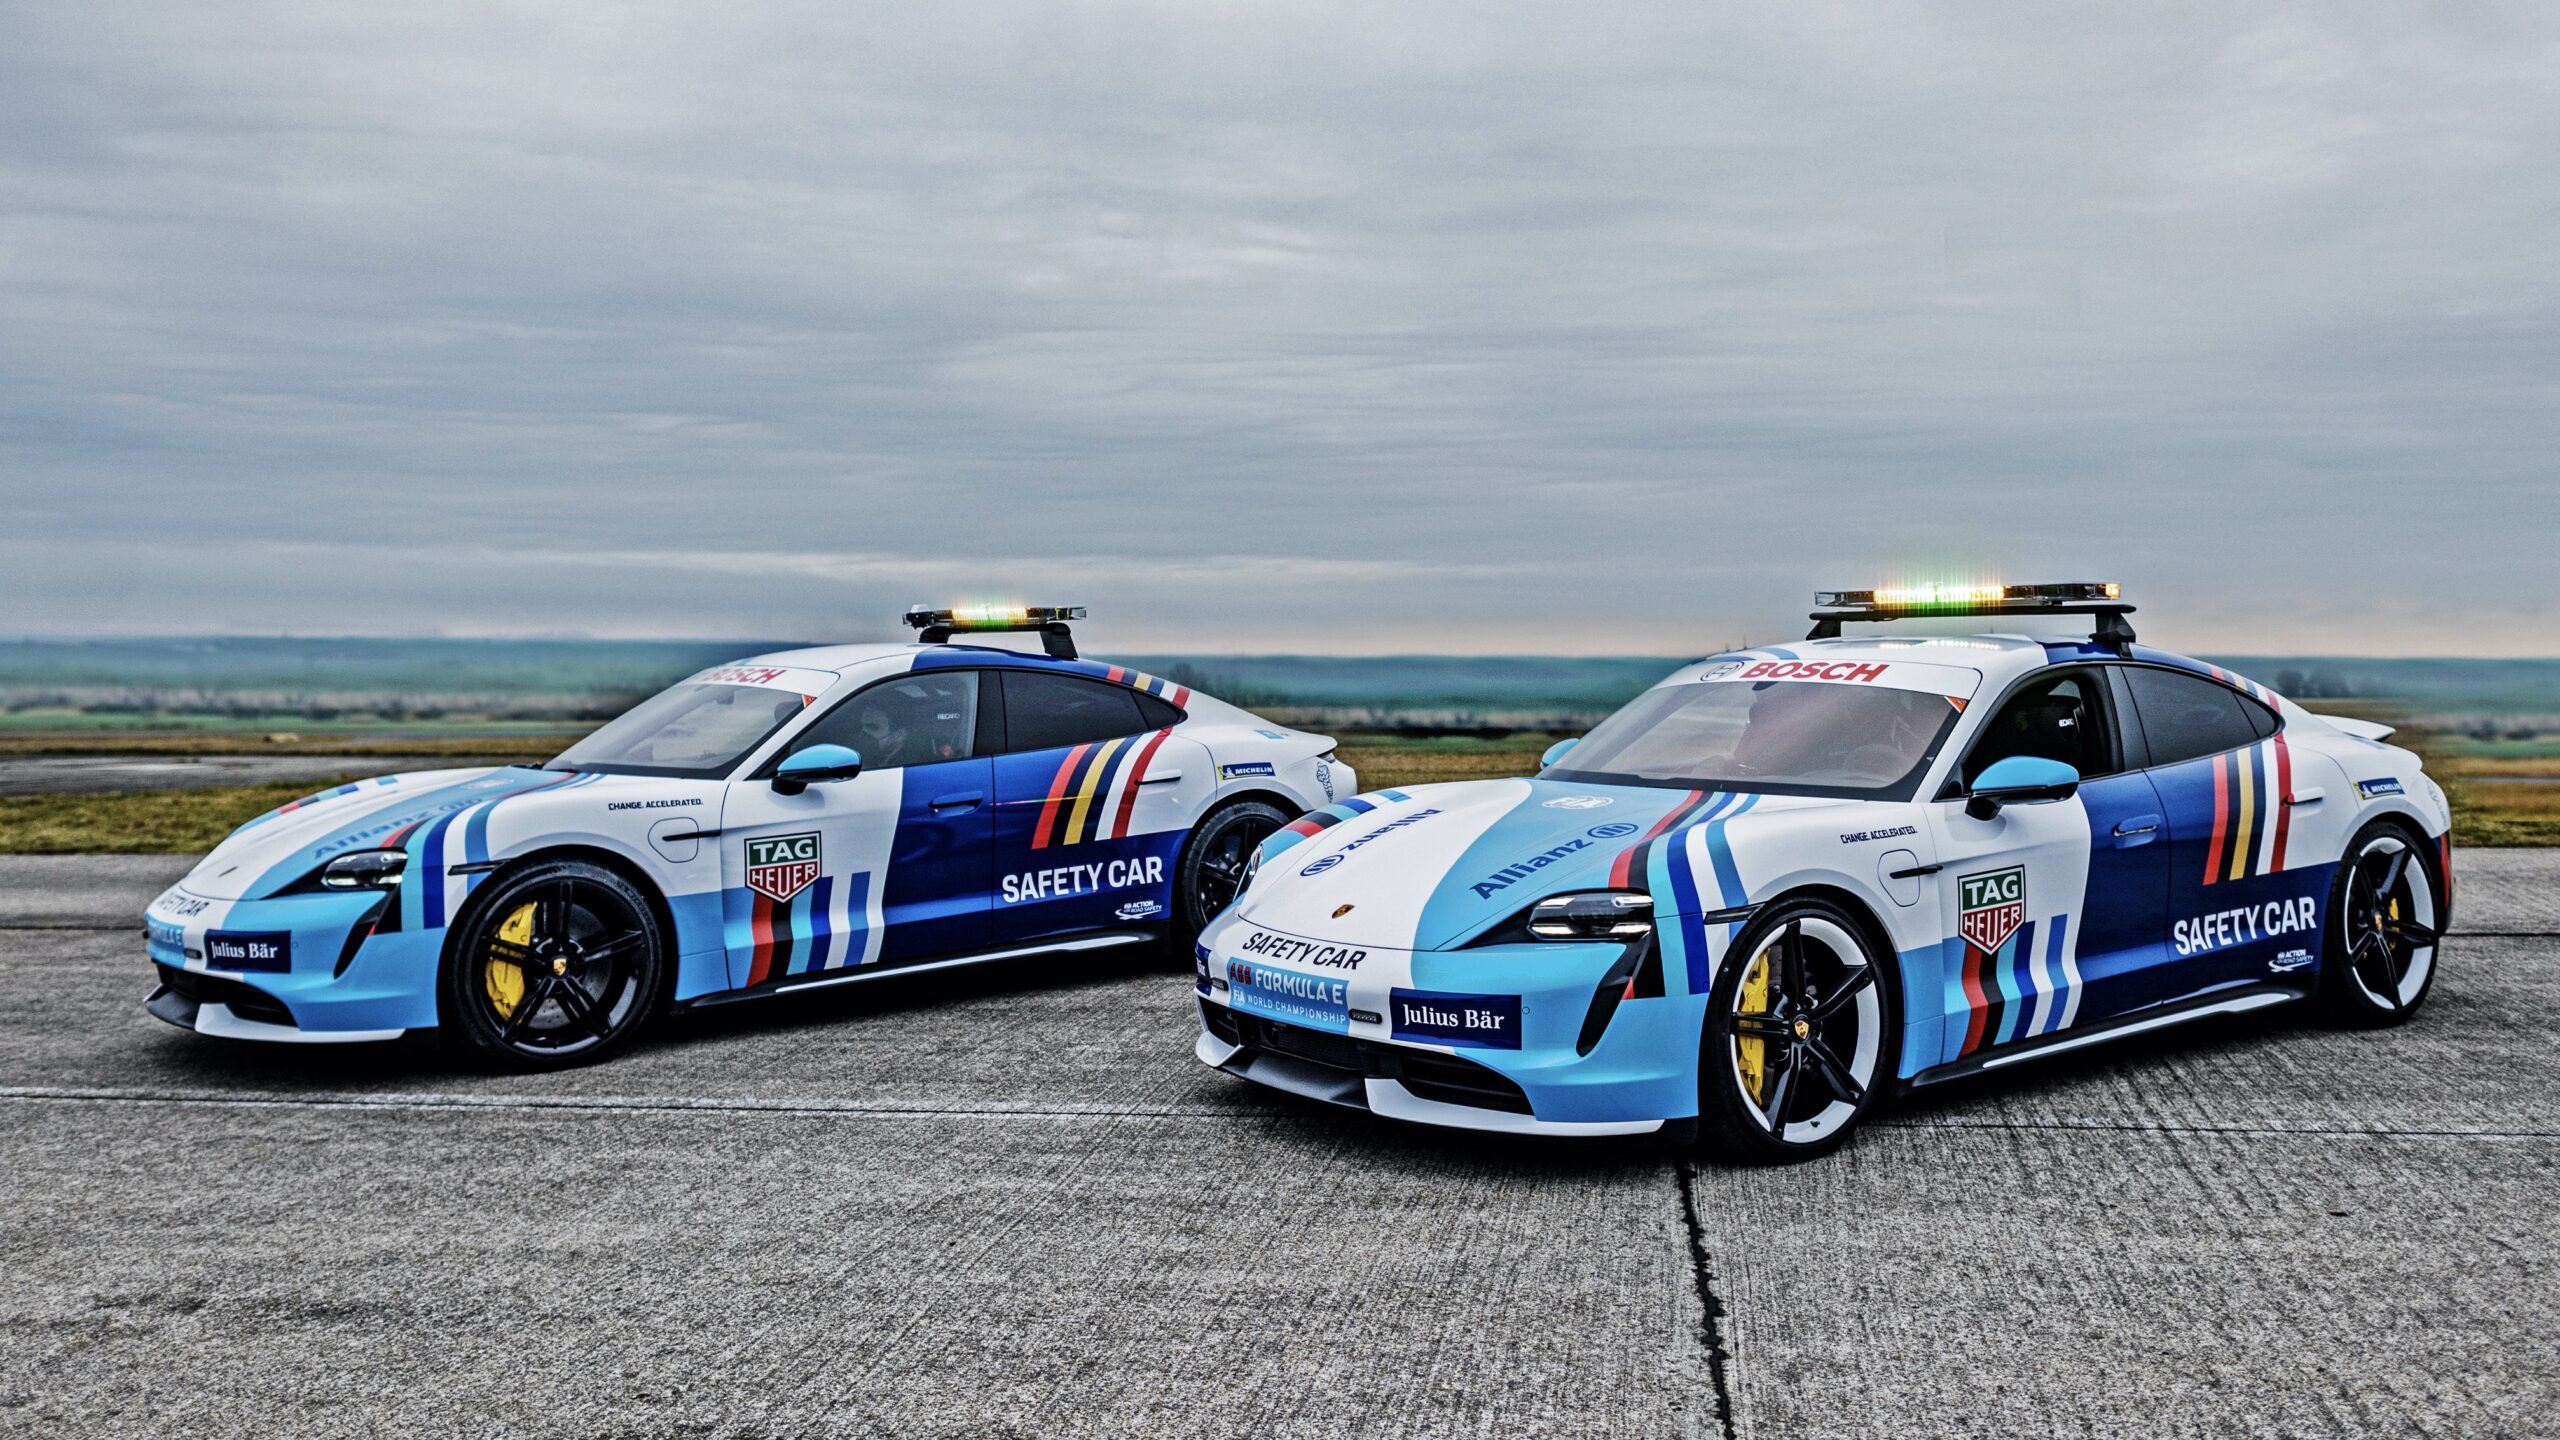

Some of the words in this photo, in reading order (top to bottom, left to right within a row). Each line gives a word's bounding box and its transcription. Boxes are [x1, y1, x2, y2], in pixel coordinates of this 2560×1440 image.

[1738, 661, 1890, 682] BOSCH
[1235, 766, 1273, 775] MICHELIN
[2371, 783, 2402, 793] MICHELIN
[608, 801, 644, 811] CHANGE.
[646, 798, 703, 808] ACCELERATED.
[314, 811, 430, 860] Allianz
[1338, 808, 1444, 852] Allianz
[1840, 831, 1870, 844] CHANGE.
[1870, 825, 1918, 840] ACCELERATED.
[752, 838, 814, 863] TAG
[751, 863, 816, 897] HEUER
[1002, 862, 1103, 903] SAFETY
[1108, 856, 1164, 888] CAR
[1469, 838, 1595, 900] Allianz
[1132, 900, 1154, 908] ACTION
[1965, 874, 2019, 906] TAG
[1964, 905, 2020, 948] HEUER
[2173, 904, 2260, 956] SAFETY
[2263, 896, 2317, 936] CAR
[211, 941, 245, 959] Julius
[248, 943, 278, 959] Bär
[1242, 932, 1319, 962] SAFETY
[1313, 946, 1367, 970] CAR
[2285, 949, 2307, 958] ACTION
[1230, 962, 1251, 985] ABB
[1255, 968, 1328, 1004] FORMULA
[1332, 983, 1344, 1005] E
[1247, 994, 1273, 1009] WORLD
[1275, 1001, 1346, 1025] CHAMPIONSHIP
[1402, 1003, 1459, 1027] Julius
[1464, 1009, 1505, 1030] Bär
